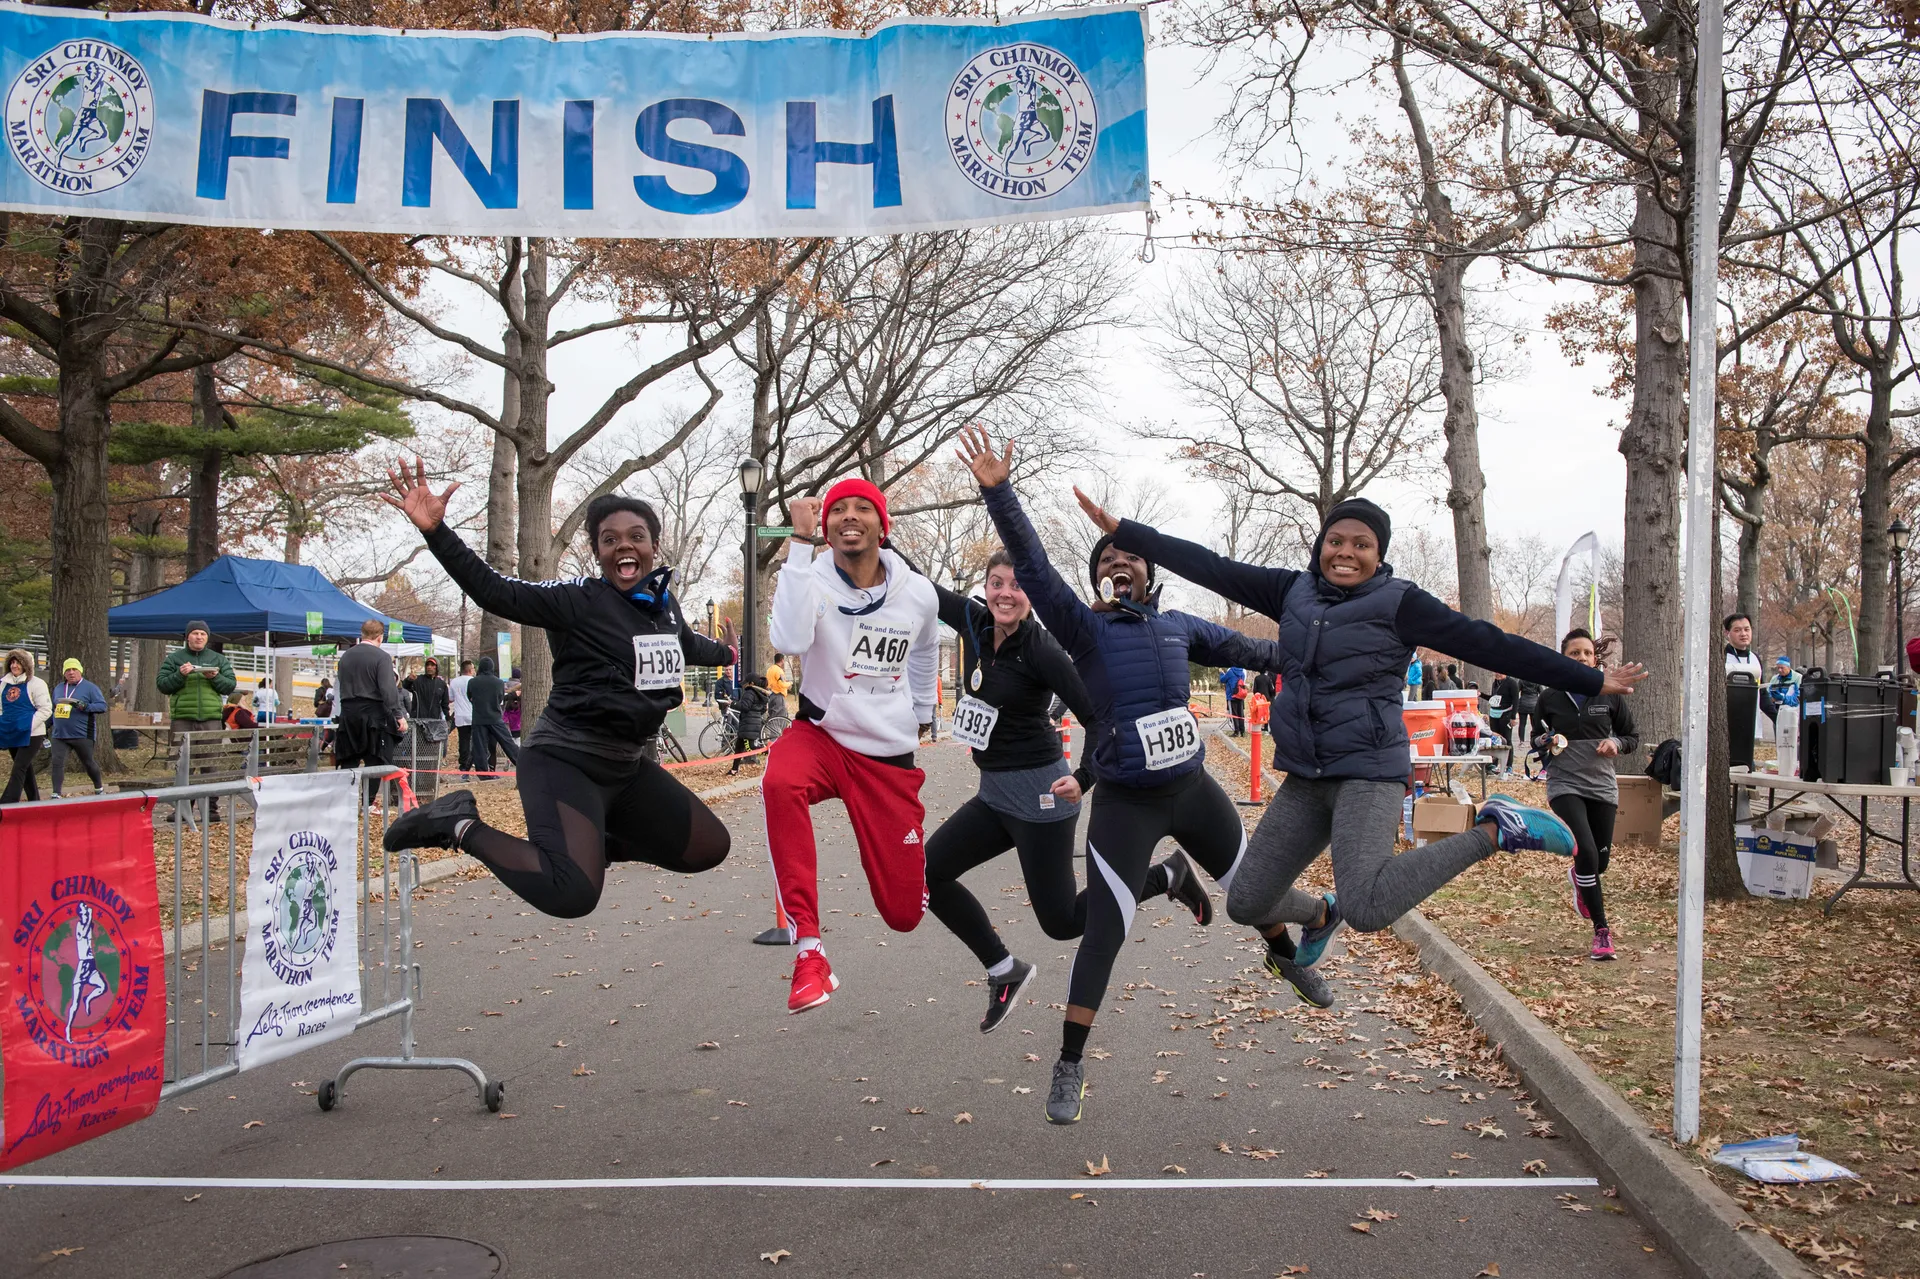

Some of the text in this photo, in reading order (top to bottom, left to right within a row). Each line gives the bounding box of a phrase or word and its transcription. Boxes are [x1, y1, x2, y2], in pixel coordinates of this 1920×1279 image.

[24, 44, 148, 92] SRI CHINMOY
[954, 48, 1081, 100] SRI CHINMOY
[10, 119, 150, 191] MARATHON TEAM
[195, 88, 903, 215] FINISH
[951, 120, 1093, 196] MARATHON TEAM
[852, 635, 908, 663] A460
[859, 622, 872, 631] Run
[888, 628, 911, 636] Become
[639, 649, 681, 674] H382
[852, 662, 878, 671] Become
[954, 706, 992, 737] H393
[1143, 721, 1156, 730] Run
[1158, 717, 1169, 725] and
[1145, 721, 1195, 756] H383
[1151, 757, 1174, 766] Become
[264, 830, 338, 884] SRI CHINMOY
[13, 875, 135, 948] SRI CHINMOY
[261, 908, 340, 986] MARATHON TEAM
[16, 964, 150, 1068] MARATHON TEAM
[246, 988, 356, 1048] Self-Transcendence
[297, 1020, 327, 1037] Races
[6, 1065, 160, 1156] Self-Transcendence
[77, 1106, 118, 1130] Races
